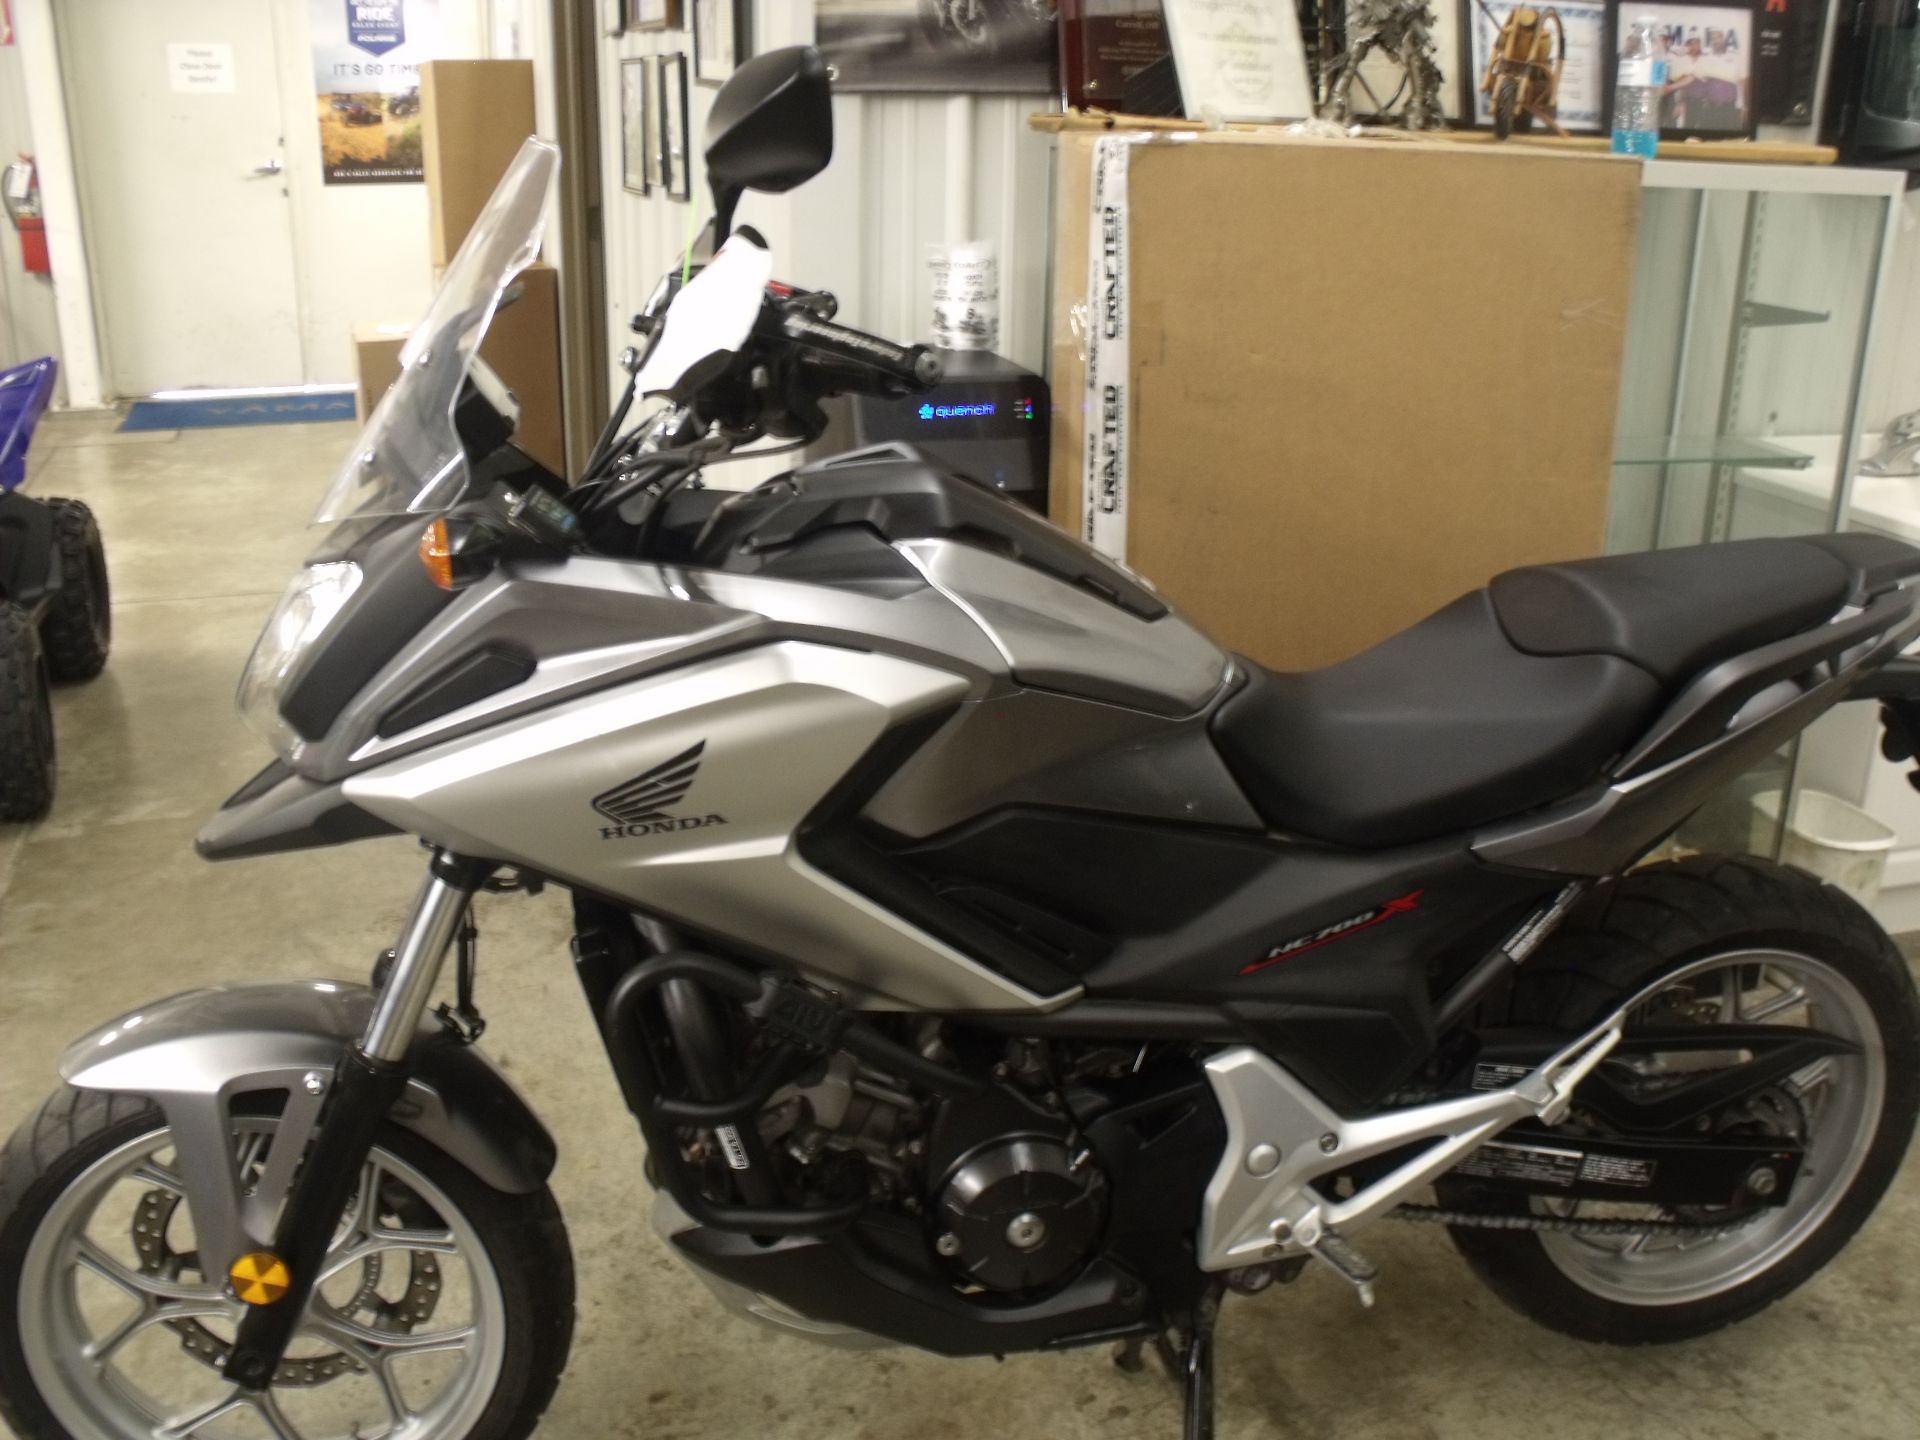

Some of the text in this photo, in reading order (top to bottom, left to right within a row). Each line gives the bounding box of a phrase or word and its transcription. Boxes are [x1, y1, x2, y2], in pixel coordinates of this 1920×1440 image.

[356, 6, 395, 21] RIDE
[333, 63, 360, 76] IT'S
[365, 63, 384, 76] GO
[1103, 206, 1117, 339] CRAFTED
[935, 403, 997, 419] quench
[1103, 385, 1117, 514] CRAFTED
[598, 813, 729, 841] HONDA
